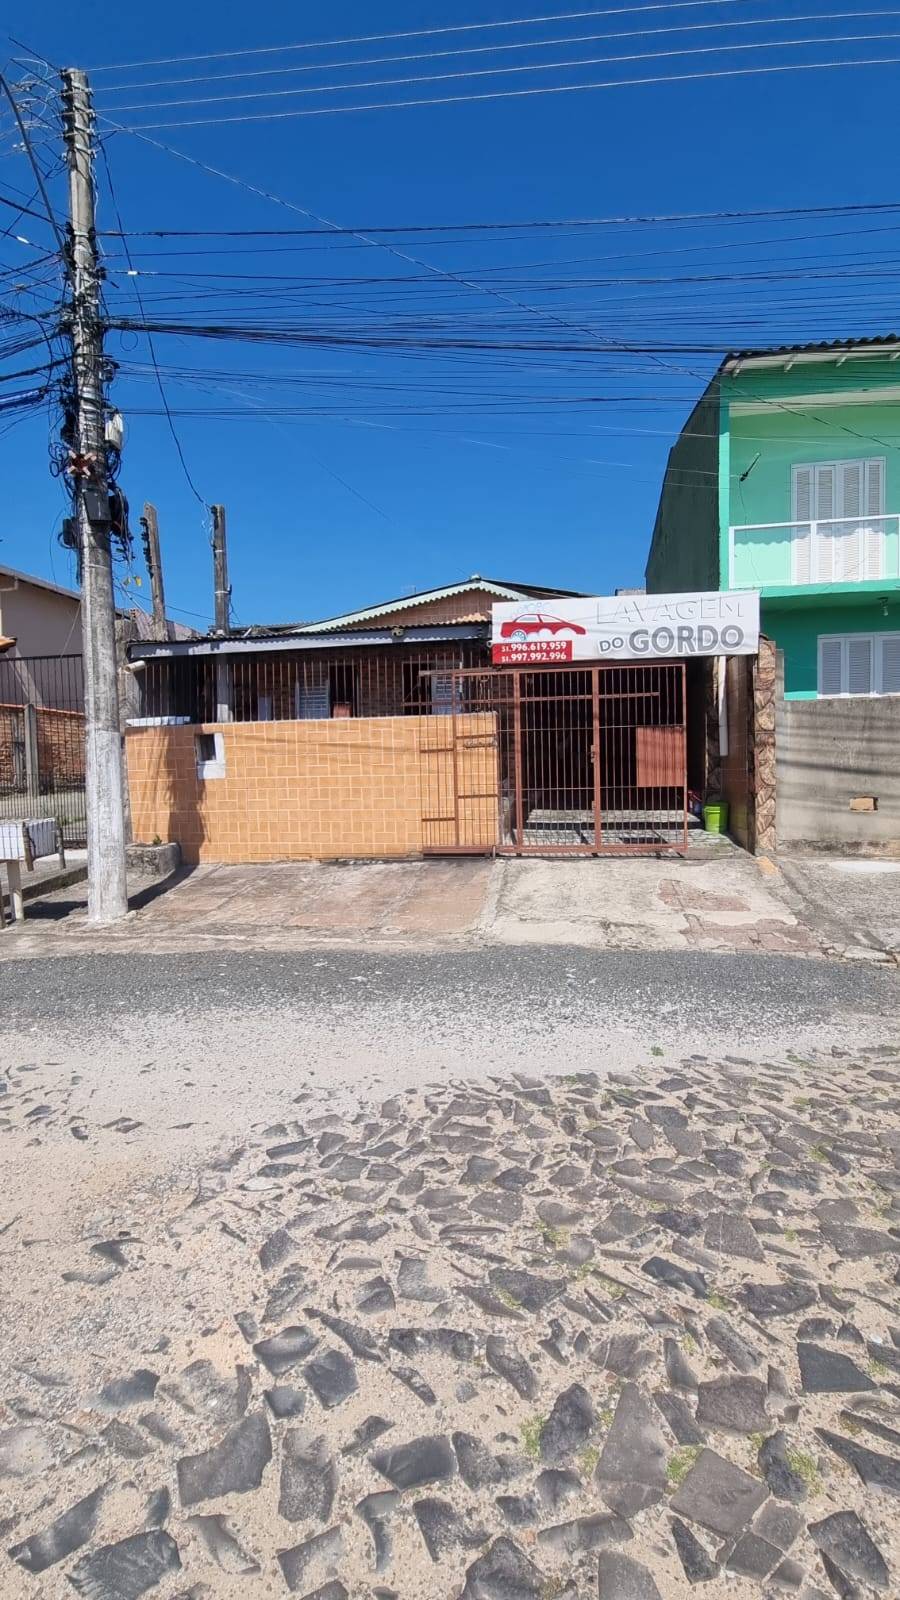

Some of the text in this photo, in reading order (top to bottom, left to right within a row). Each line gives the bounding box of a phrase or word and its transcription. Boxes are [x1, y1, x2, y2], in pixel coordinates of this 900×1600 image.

[597, 596, 744, 624] LAVAGEM
[599, 624, 745, 653] DO GORDO
